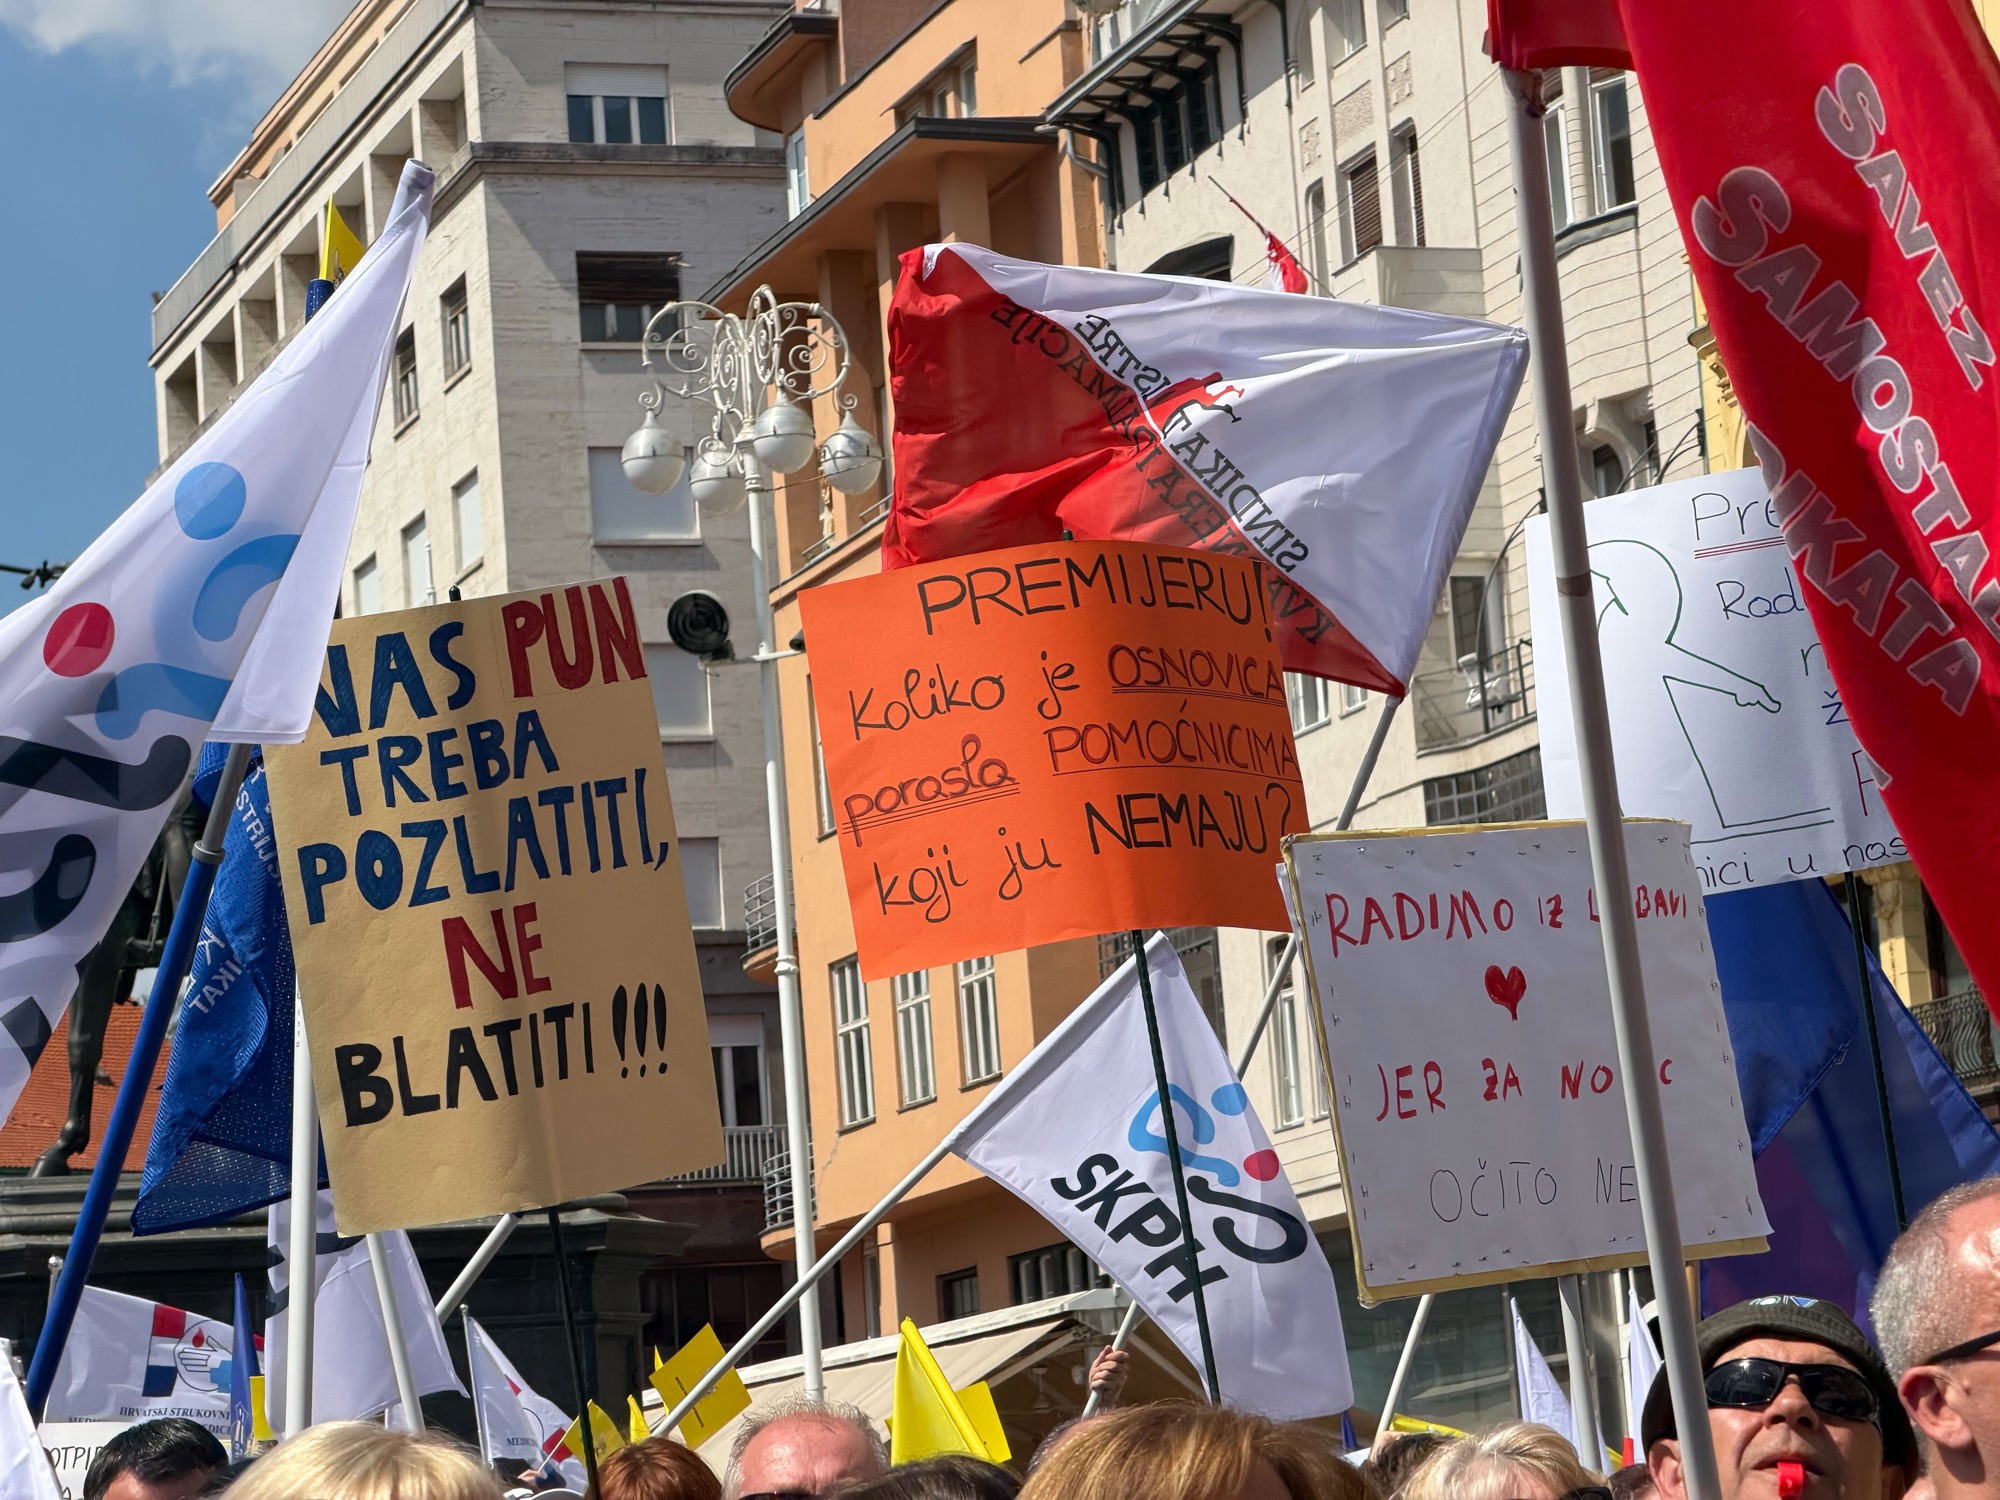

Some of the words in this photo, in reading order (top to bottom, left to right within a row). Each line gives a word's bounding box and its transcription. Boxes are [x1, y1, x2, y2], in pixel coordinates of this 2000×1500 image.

[1814, 63, 1997, 391] SAVEZ
[1691, 492, 1781, 541] Pre
[501, 576, 648, 698] PUN
[917, 553, 1273, 642] PREMIJERU!
[1716, 566, 1805, 620] Rad
[848, 663, 1006, 741] Koliko
[1037, 650, 1080, 720] je
[1107, 643, 1286, 701] OSNOVICA
[320, 709, 560, 817] TREBA
[841, 733, 1017, 847] porasla
[1043, 698, 1301, 776] POMOĆNICIMA
[297, 768, 669, 925] POZLATITI,
[873, 844, 969, 923] koji
[998, 826, 1062, 900] ju
[1084, 783, 1292, 855] NEMAJU?
[1787, 853, 1818, 875] u
[441, 902, 552, 1010] NE
[1325, 889, 1515, 959] RADIMO
[1537, 893, 1564, 929] IZ
[1588, 885, 1687, 923] LBAVI
[1376, 1060, 1446, 1122] JER
[1481, 1058, 1523, 1102] ZA
[1560, 1058, 1673, 1102] NOC
[1050, 1152, 1230, 1304] SKPH
[1429, 1157, 1557, 1223] OČITO
[119, 1406, 168, 1418] HRVATSKI
[170, 1407, 230, 1421] STRUKOVNI
